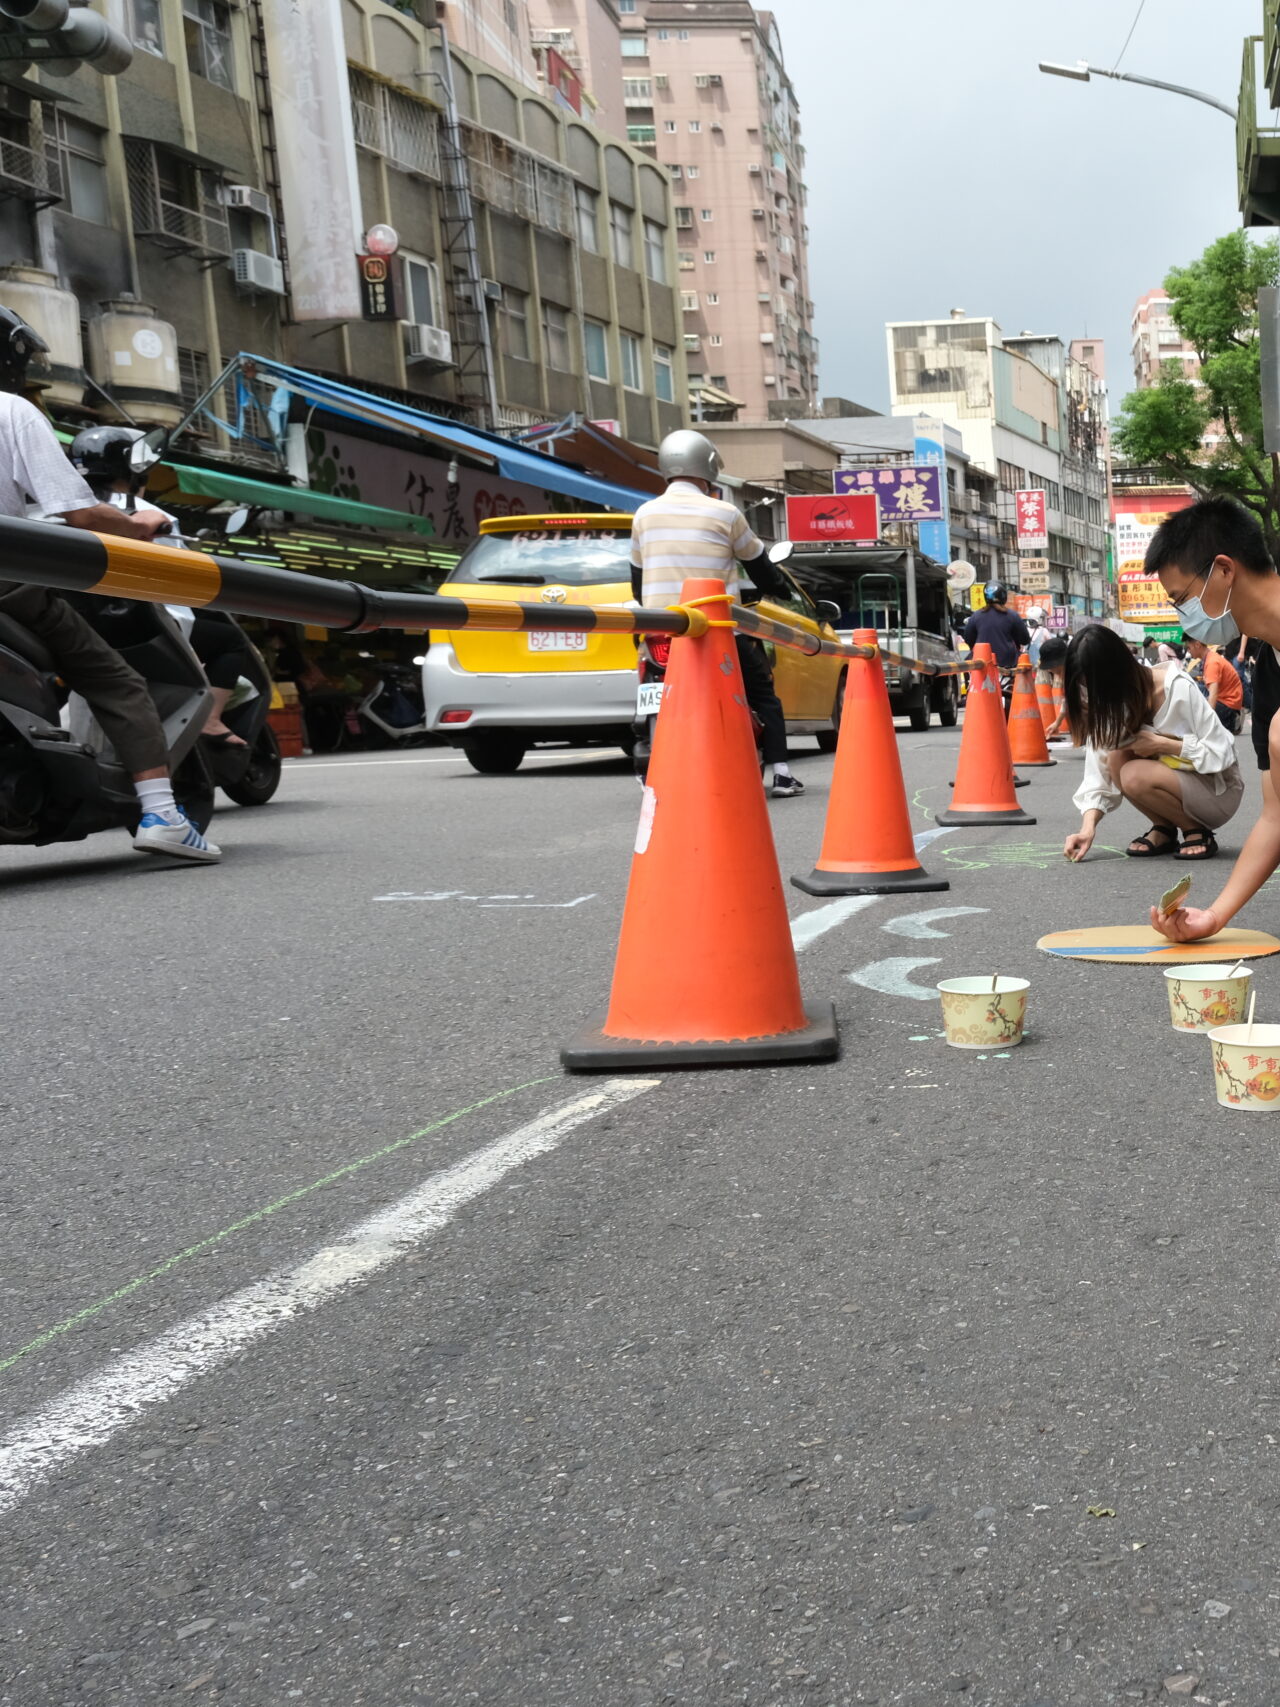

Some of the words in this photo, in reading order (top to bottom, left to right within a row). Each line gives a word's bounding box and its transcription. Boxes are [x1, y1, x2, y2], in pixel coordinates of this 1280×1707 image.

[511, 530, 617, 549] 621-E8
[530, 632, 584, 647] 621-E8
[1199, 987, 1239, 1021] 事事如意
